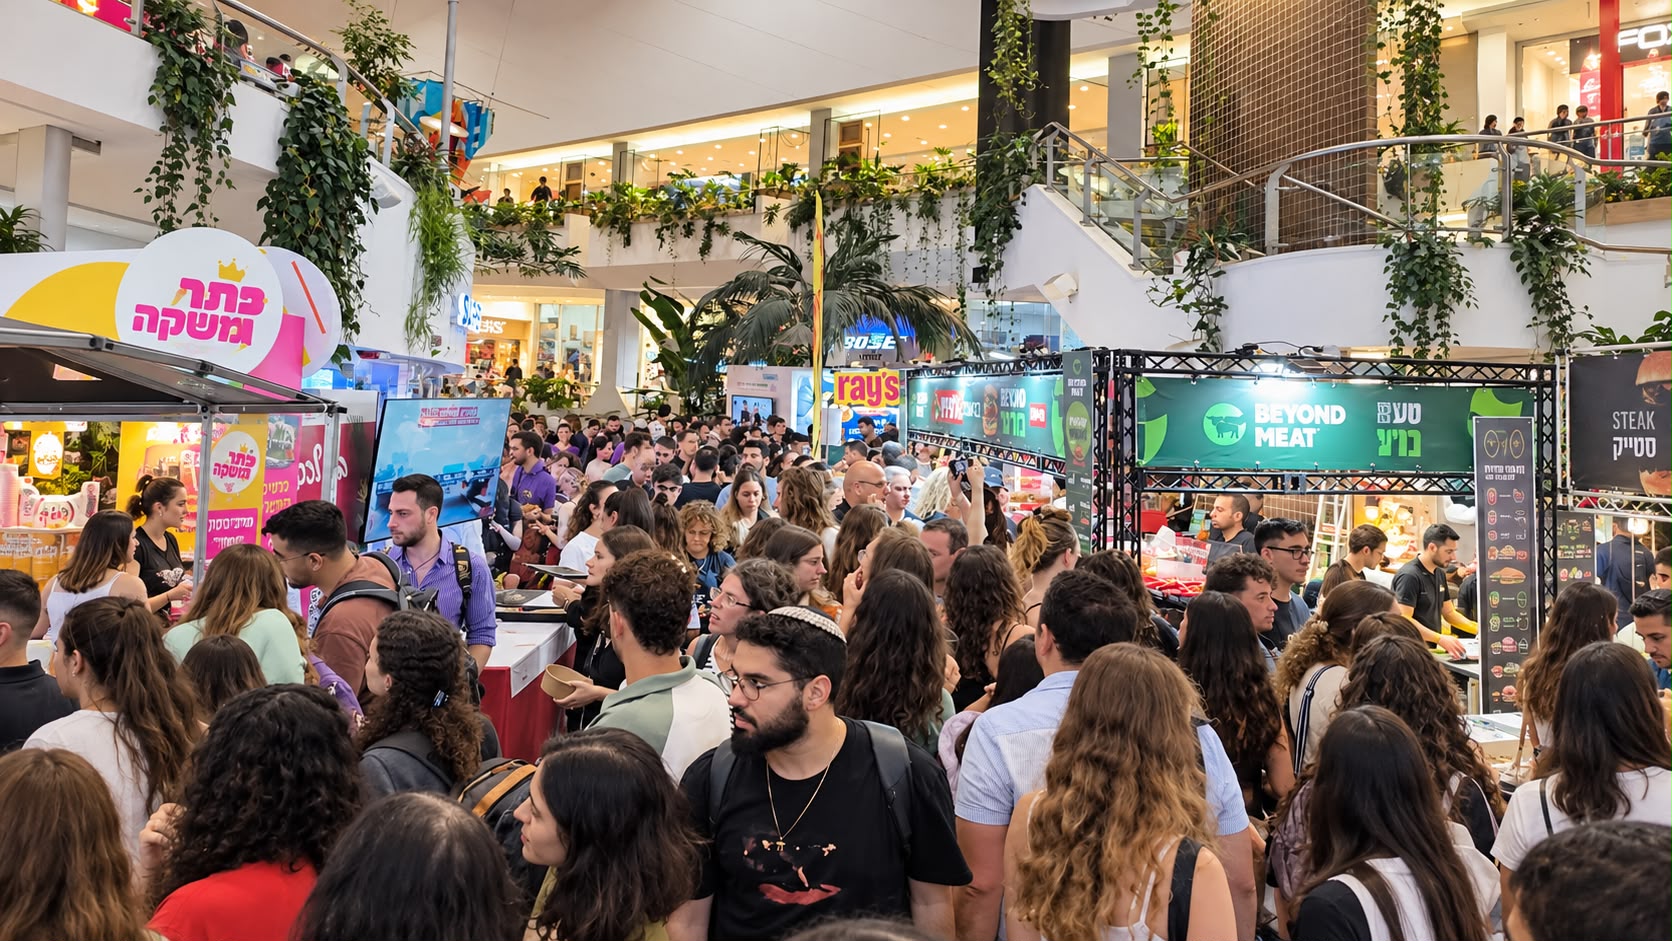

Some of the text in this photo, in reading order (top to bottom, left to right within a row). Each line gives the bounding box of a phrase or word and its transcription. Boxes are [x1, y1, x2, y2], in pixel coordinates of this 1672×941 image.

[180, 277, 265, 316] כתר
[132, 303, 254, 346] ומשקה
[838, 370, 899, 407] ray's
[1254, 402, 1346, 425] BEYOND
[1612, 410, 1656, 430] STEAK
[1254, 427, 1317, 448] MEAT
[1612, 436, 1657, 460] סטייק
[228, 451, 256, 468] כתר
